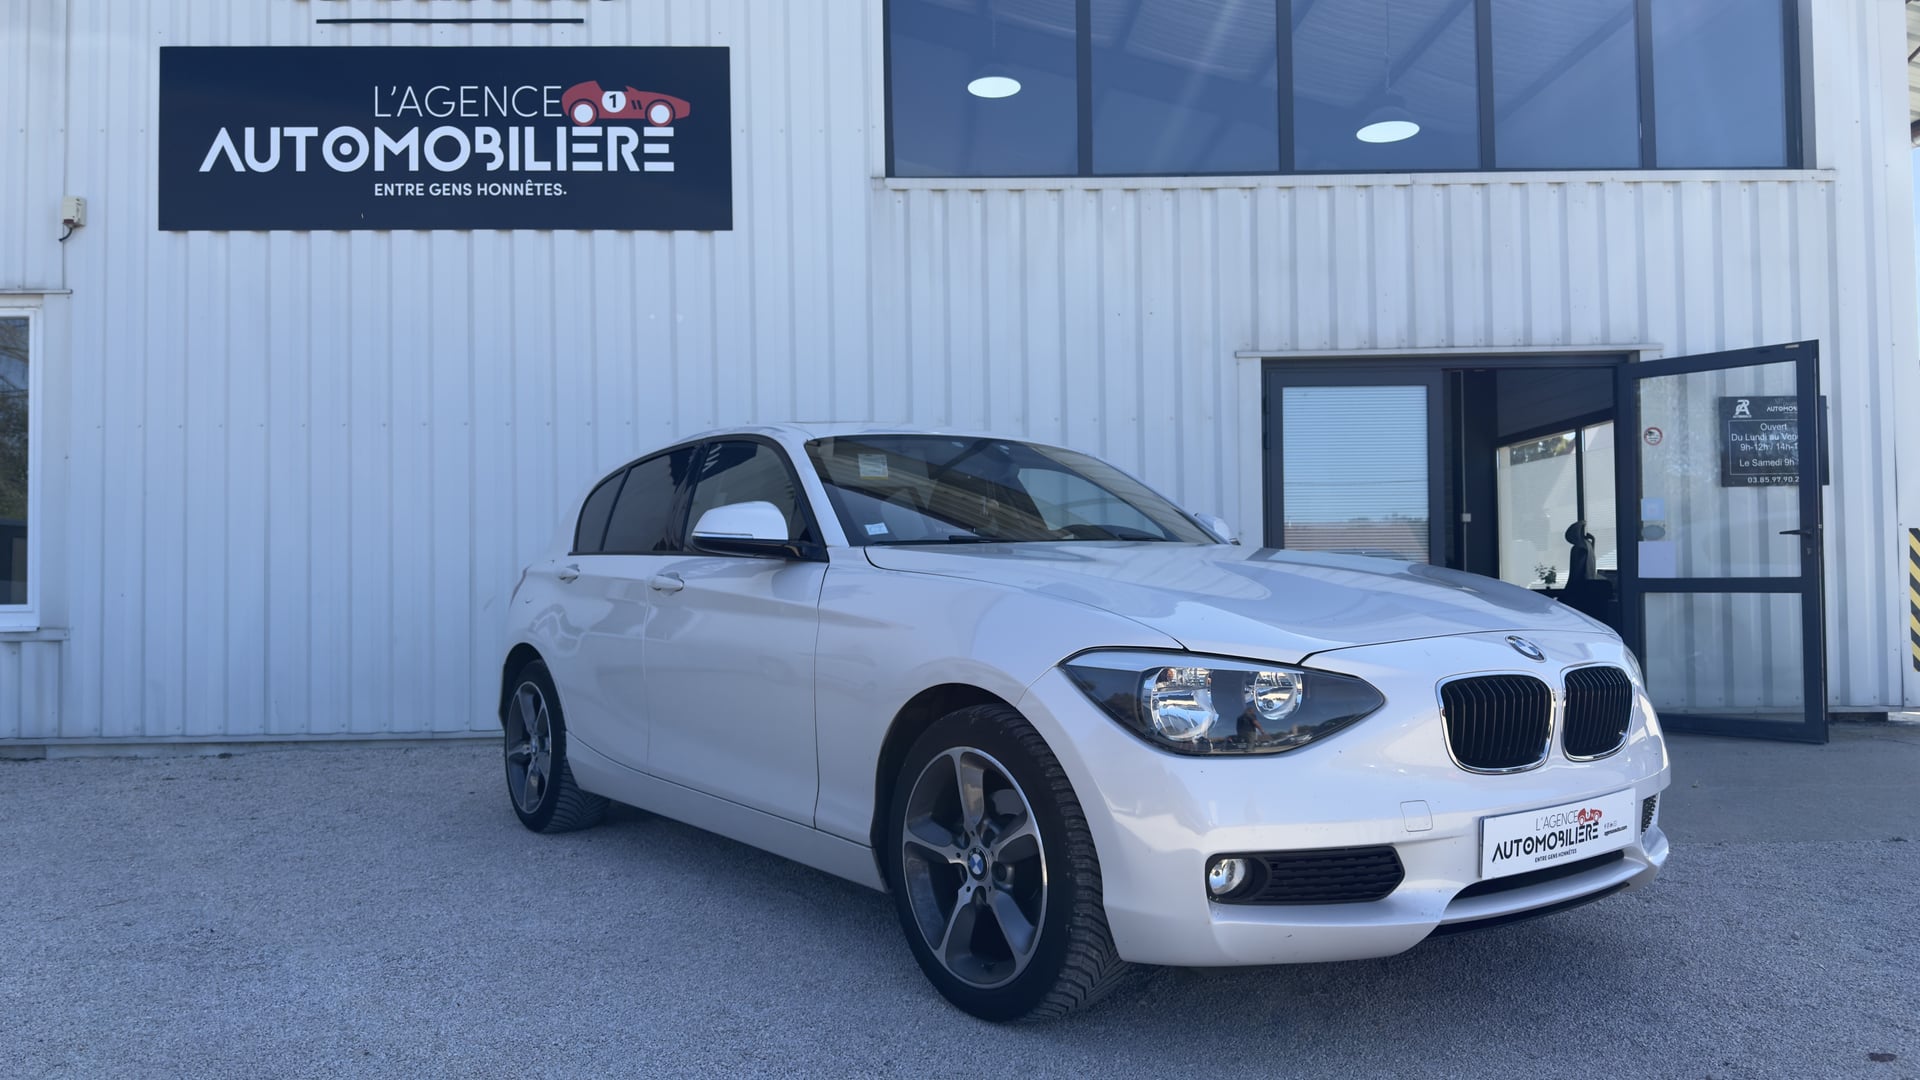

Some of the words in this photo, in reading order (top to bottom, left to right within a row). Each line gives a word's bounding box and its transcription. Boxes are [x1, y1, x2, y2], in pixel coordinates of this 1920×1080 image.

[374, 183, 425, 196] ENTRE
[428, 183, 473, 196] GENS
[476, 179, 568, 196] HONNÊTES.
[1760, 423, 1787, 431] Ouvert
[1731, 433, 1743, 441] Du
[1745, 432, 1767, 441] Lundi
[1739, 459, 1750, 467] Le
[1752, 459, 1783, 467] Samedi
